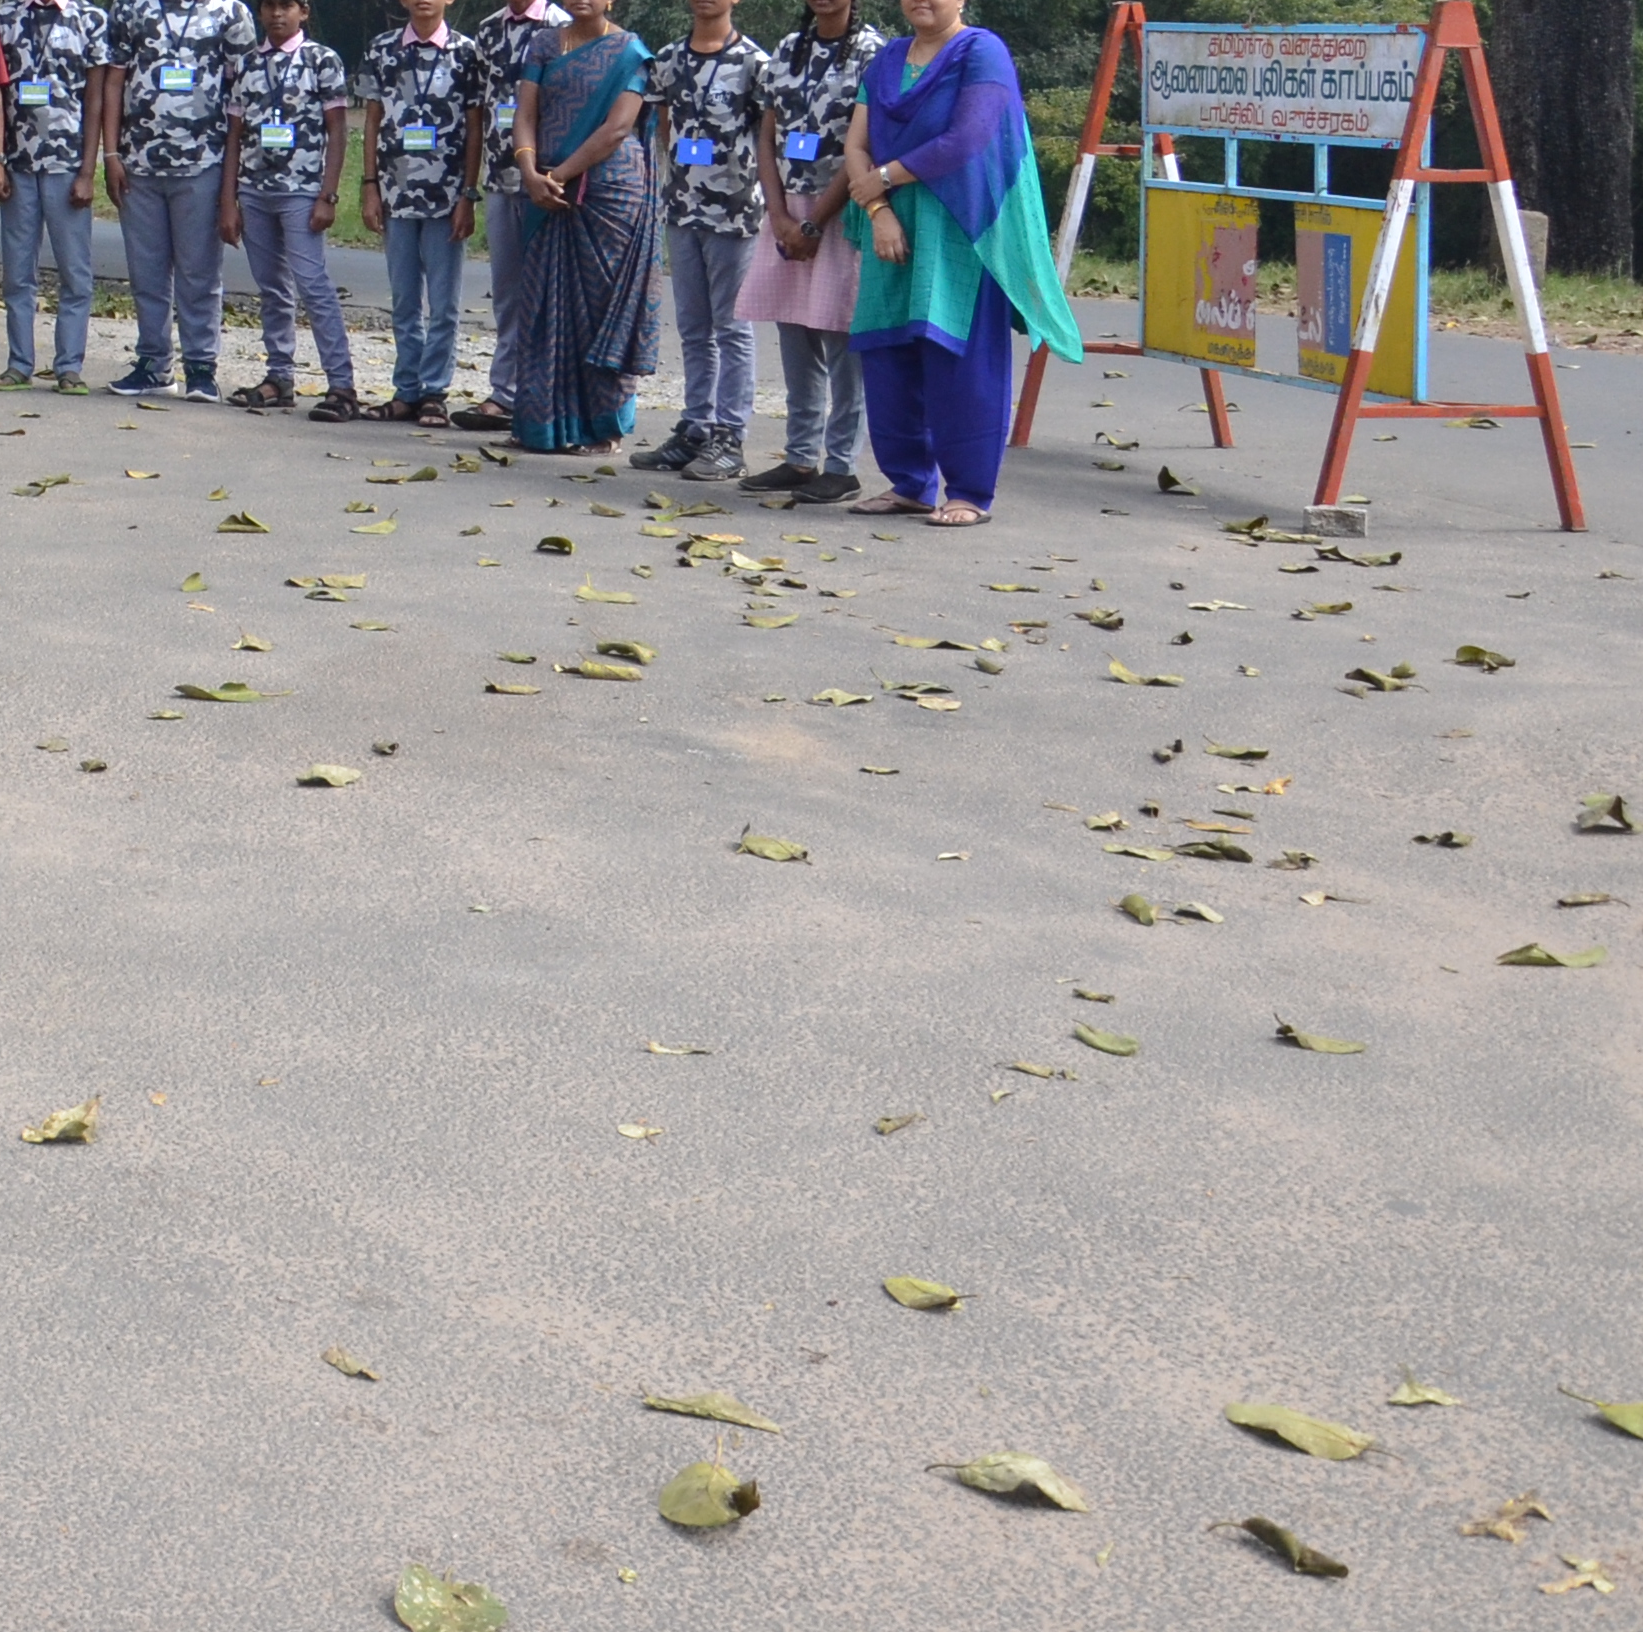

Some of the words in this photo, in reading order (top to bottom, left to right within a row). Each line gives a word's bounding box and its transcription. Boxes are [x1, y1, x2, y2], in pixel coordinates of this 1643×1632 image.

[1279, 33, 1367, 62] வனத்துறை
[1150, 59, 1248, 100] ஆனைமலை
[1252, 59, 1317, 101] புலிகள்
[1320, 59, 1415, 103] காப்பகம்
[1200, 102, 1265, 125] டாப்சிலிப்
